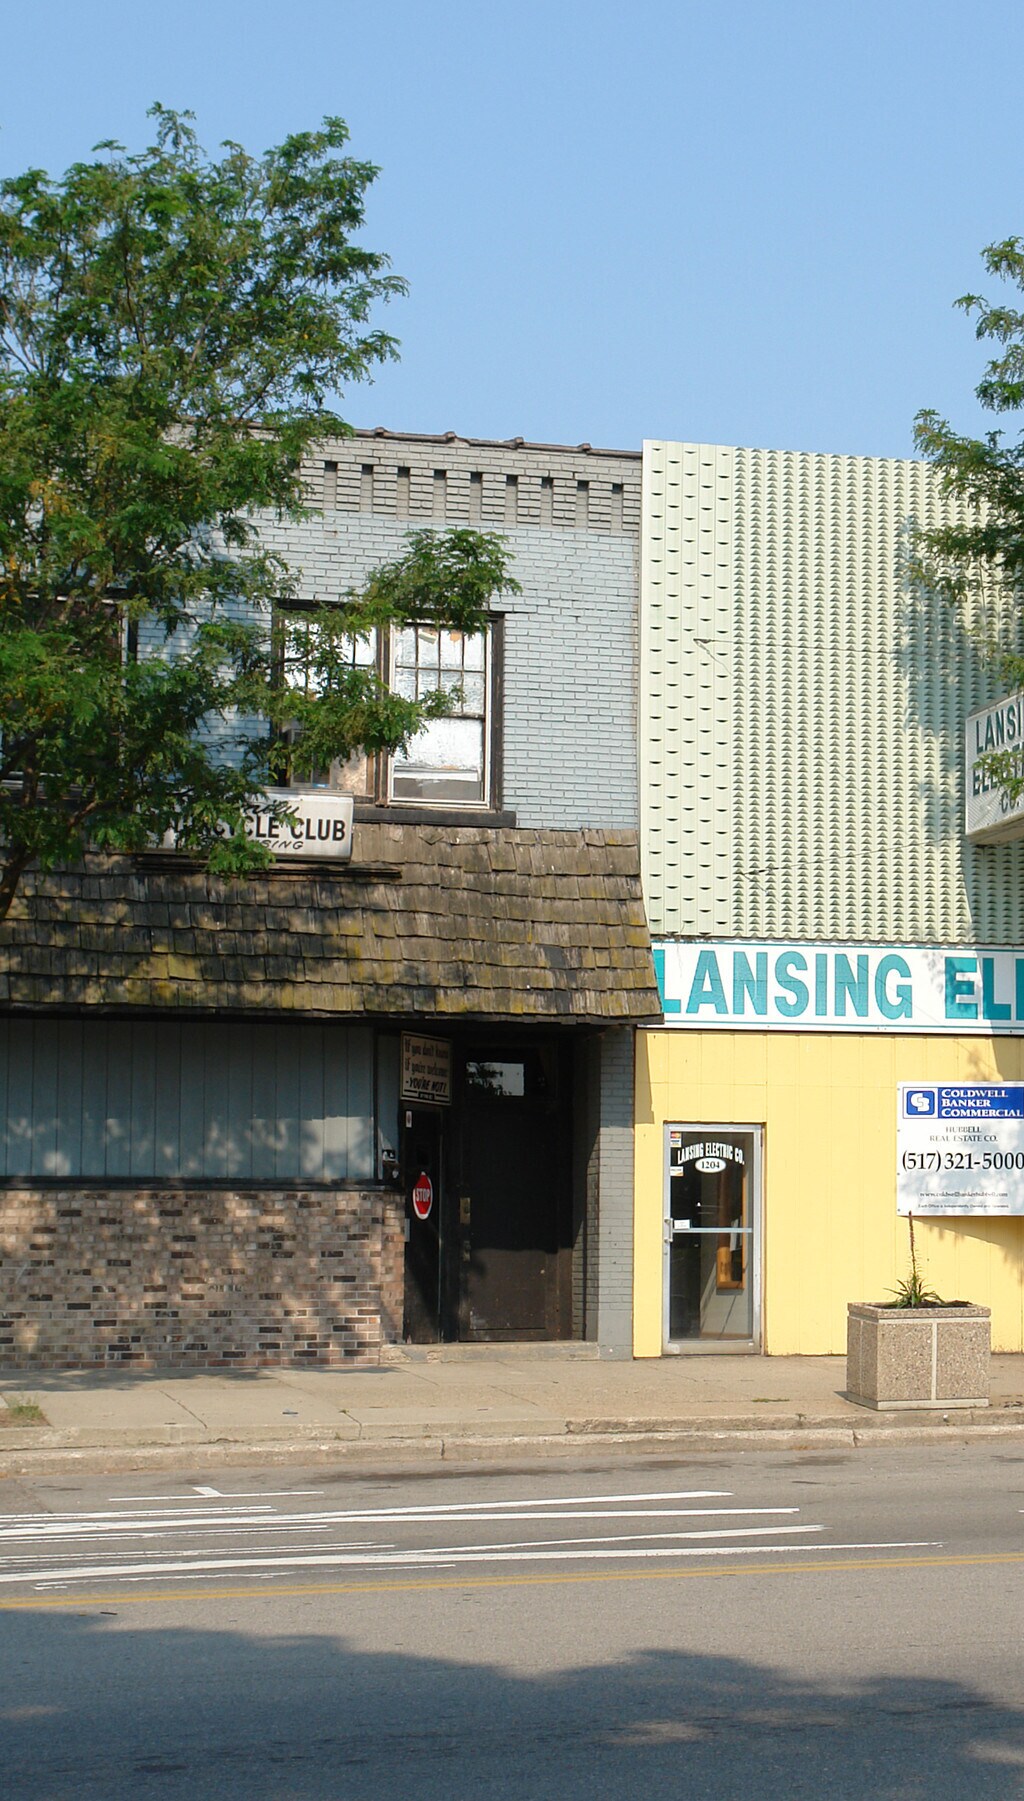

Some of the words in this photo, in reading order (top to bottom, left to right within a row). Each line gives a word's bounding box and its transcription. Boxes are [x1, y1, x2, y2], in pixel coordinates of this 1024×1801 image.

[289, 817, 345, 841] CLUB
[653, 949, 914, 1020] LANSING
[941, 1088, 1009, 1098] COLDWELL
[941, 1099, 991, 1107] BANKER
[941, 1108, 1024, 1118] COMMERCIAL
[677, 1143, 704, 1165] LANSING
[705, 1142, 733, 1160] ELECTRIC
[701, 1161, 720, 1169] 1204
[902, 1150, 942, 1173] (517)
[415, 1187, 430, 1202] STOP
